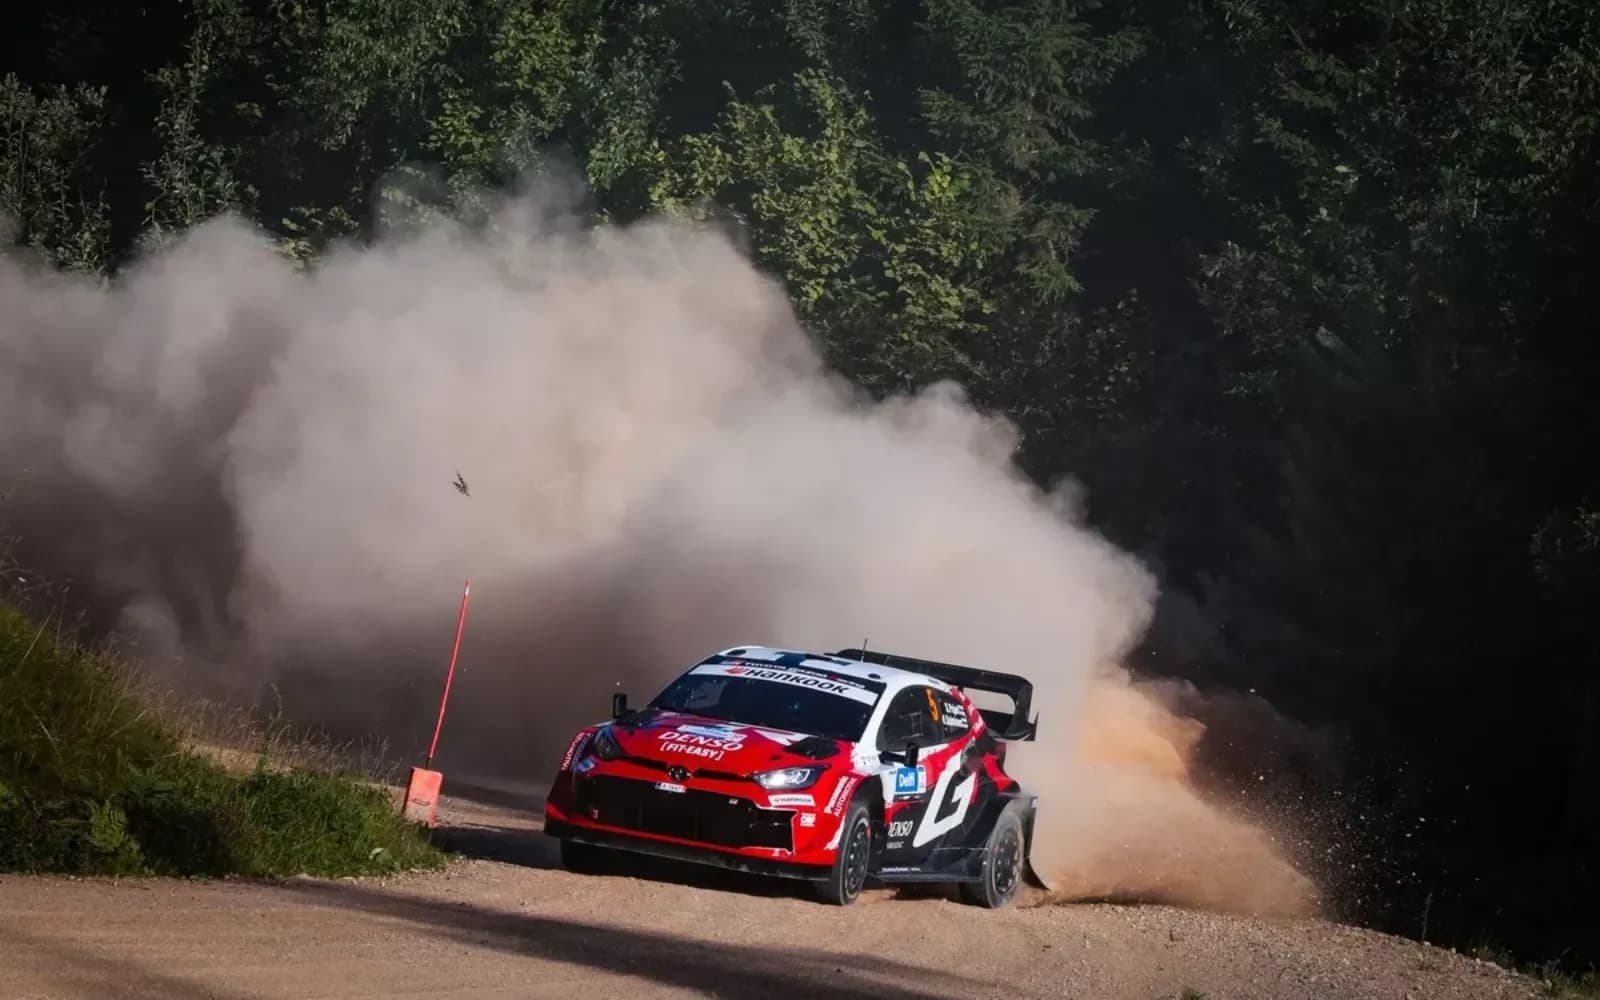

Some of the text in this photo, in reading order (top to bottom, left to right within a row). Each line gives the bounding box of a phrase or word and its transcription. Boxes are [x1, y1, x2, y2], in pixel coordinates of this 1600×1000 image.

[925, 688, 939, 722] 5
[658, 731, 743, 751] DENSO
[912, 750, 977, 848] G
